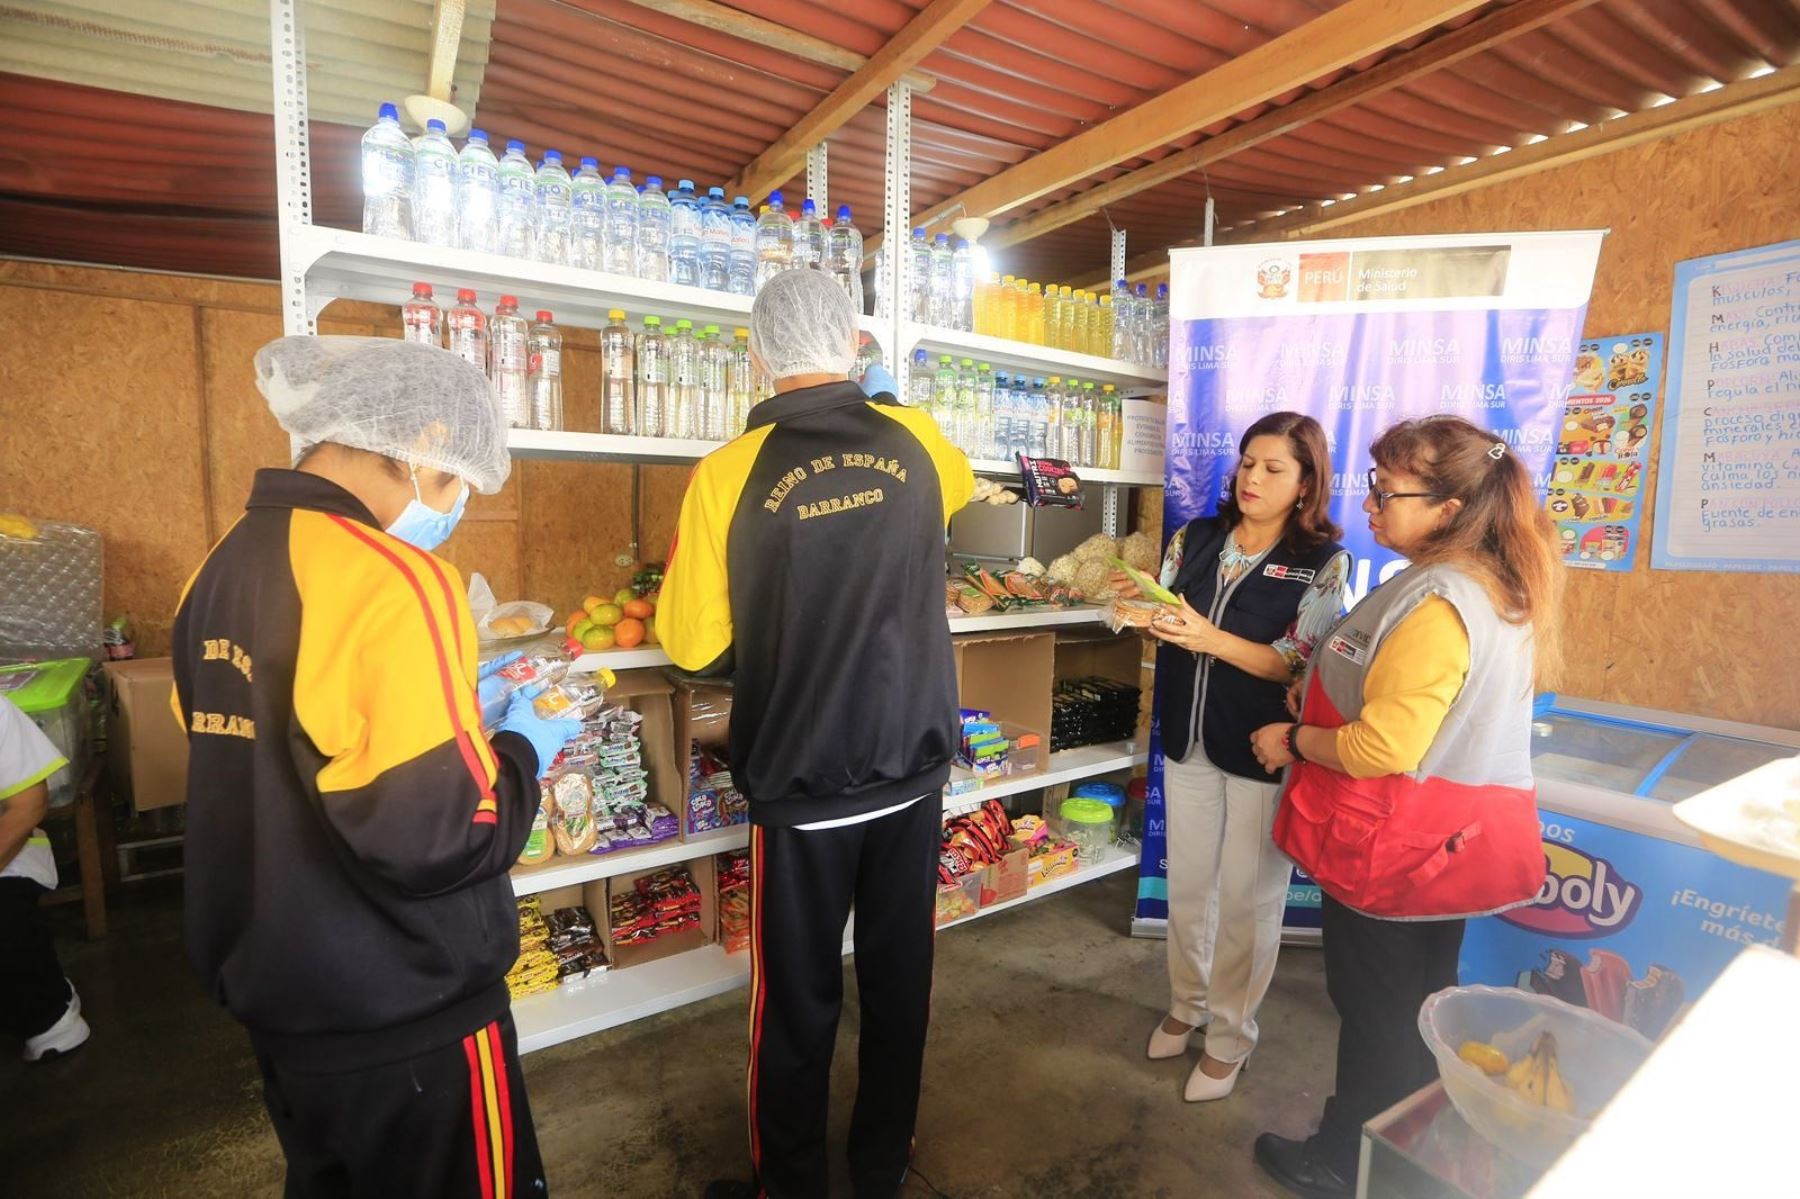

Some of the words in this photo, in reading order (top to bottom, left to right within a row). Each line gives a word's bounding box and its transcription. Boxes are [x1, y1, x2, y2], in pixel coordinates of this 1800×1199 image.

[1304, 267, 1343, 284] PERÚ
[1358, 267, 1417, 280] Ministerio
[1357, 280, 1371, 292] de
[1375, 281, 1407, 292] Salud
[1391, 337, 1460, 355] MINSA
[1501, 336, 1572, 355] MINSA
[1727, 343, 1772, 361] salud
[1328, 384, 1395, 402] MINSA
[1441, 384, 1506, 401] MINSA
[1708, 385, 1758, 402] regula
[1765, 382, 1779, 393] el
[1703, 422, 1782, 436] minerales
[1704, 414, 1764, 430] proceso
[1172, 432, 1235, 448] MINSA
[1535, 444, 1553, 453] SUR
[1701, 461, 1775, 472] vitamina
[1757, 469, 1779, 480] los
[763, 466, 808, 514] REINO
[810, 455, 836, 474] DE
[841, 453, 909, 484] ESPAÑA
[797, 488, 885, 520] BARRANCO
[1758, 506, 1775, 518] de
[203, 638, 231, 661] DE
[1700, 918, 1756, 946] más
